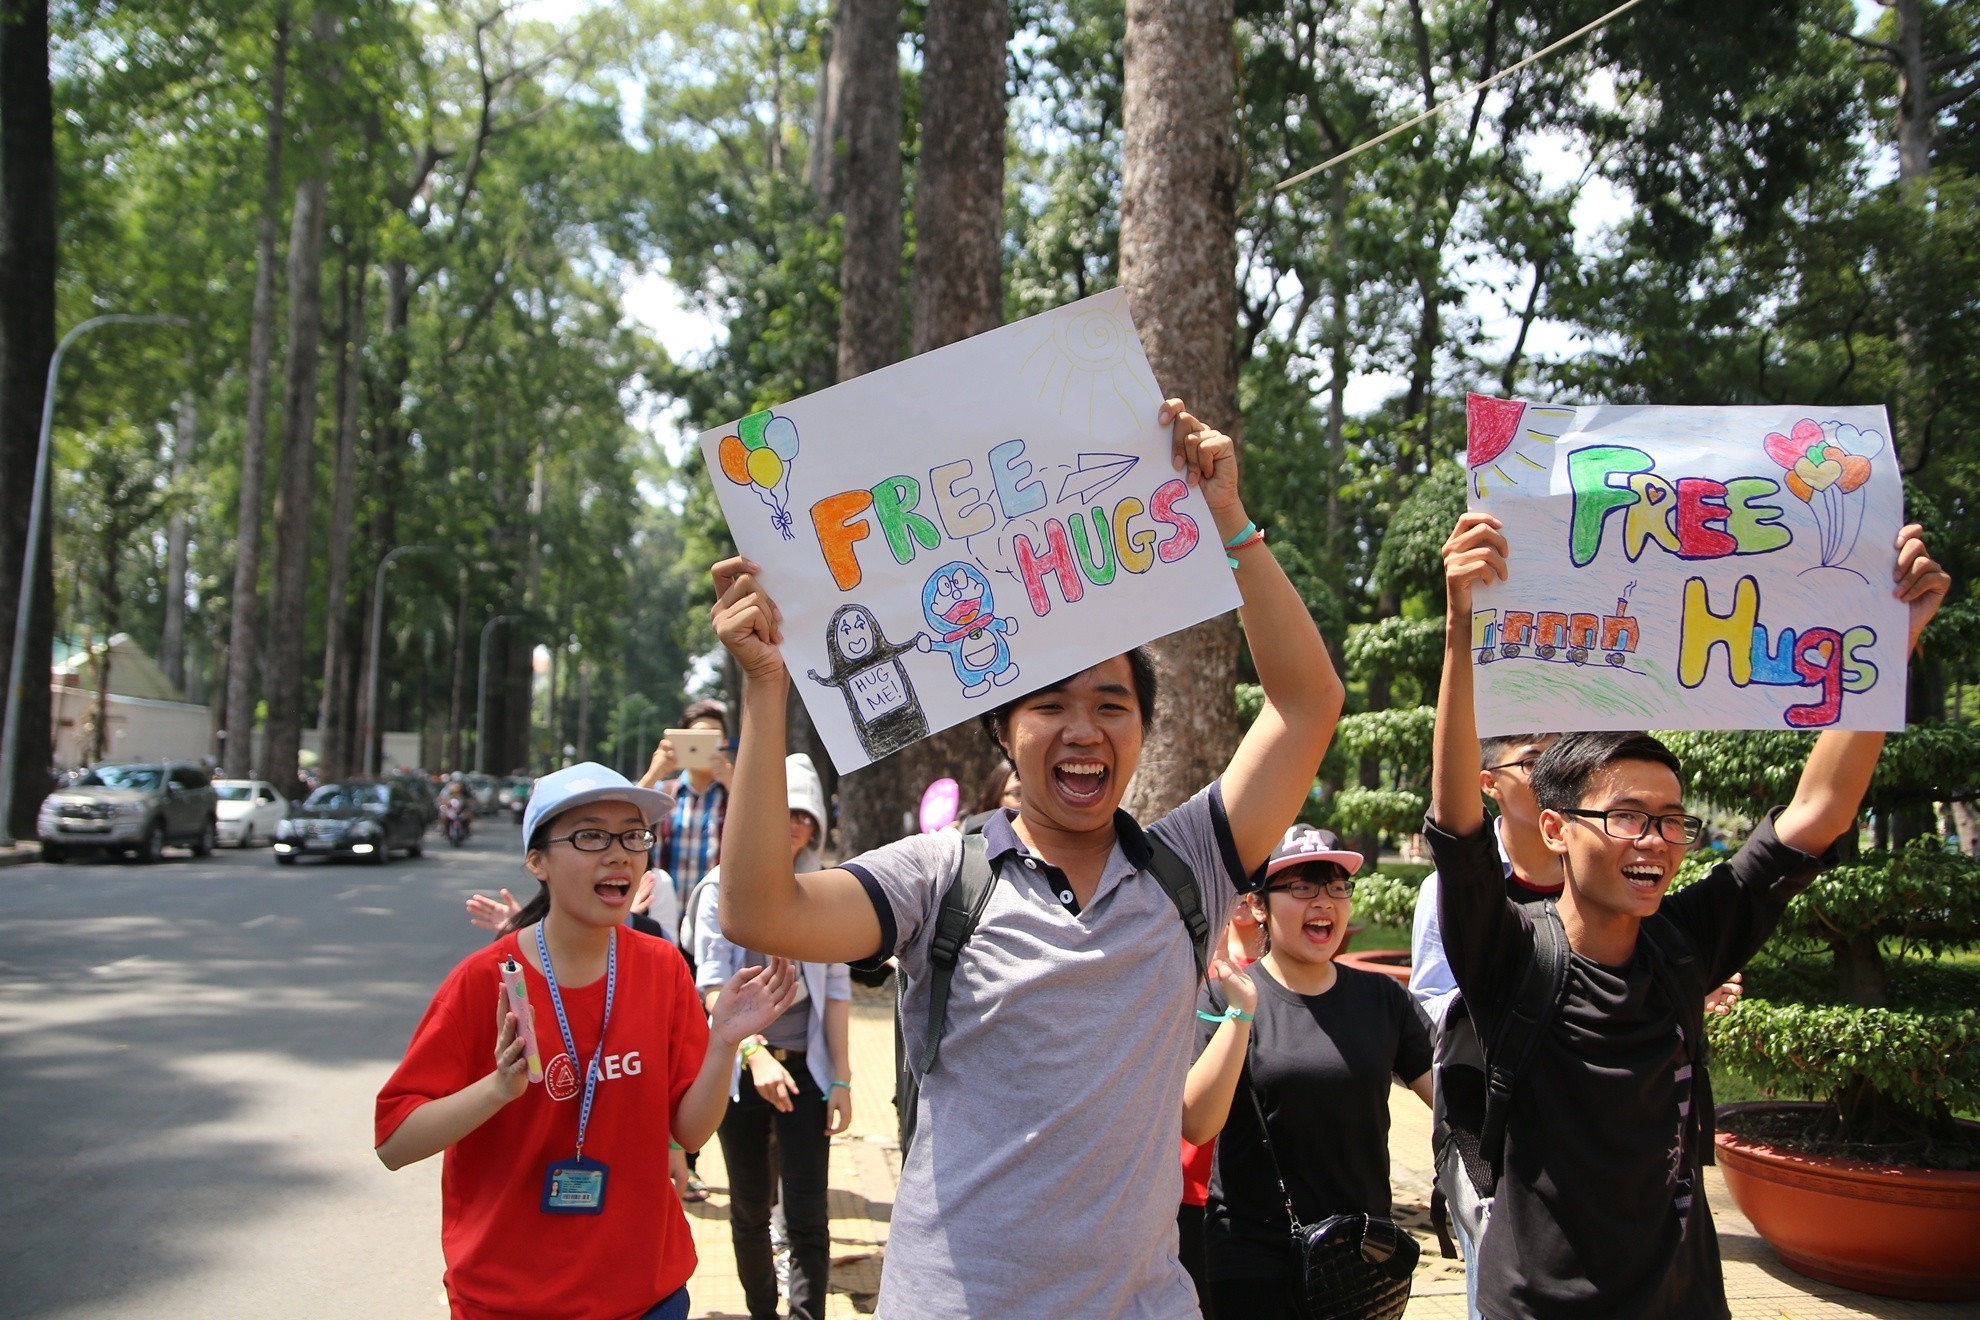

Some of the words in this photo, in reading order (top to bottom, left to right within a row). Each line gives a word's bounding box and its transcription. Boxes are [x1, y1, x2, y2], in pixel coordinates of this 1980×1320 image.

[810, 439, 1048, 591] FREE
[1013, 479, 1200, 617] HUGS
[1568, 445, 1793, 568] FREE
[854, 667, 889, 693] HUG
[866, 680, 902, 711] ME!
[1678, 575, 1879, 728] Hugs
[1282, 826, 1330, 853] LA
